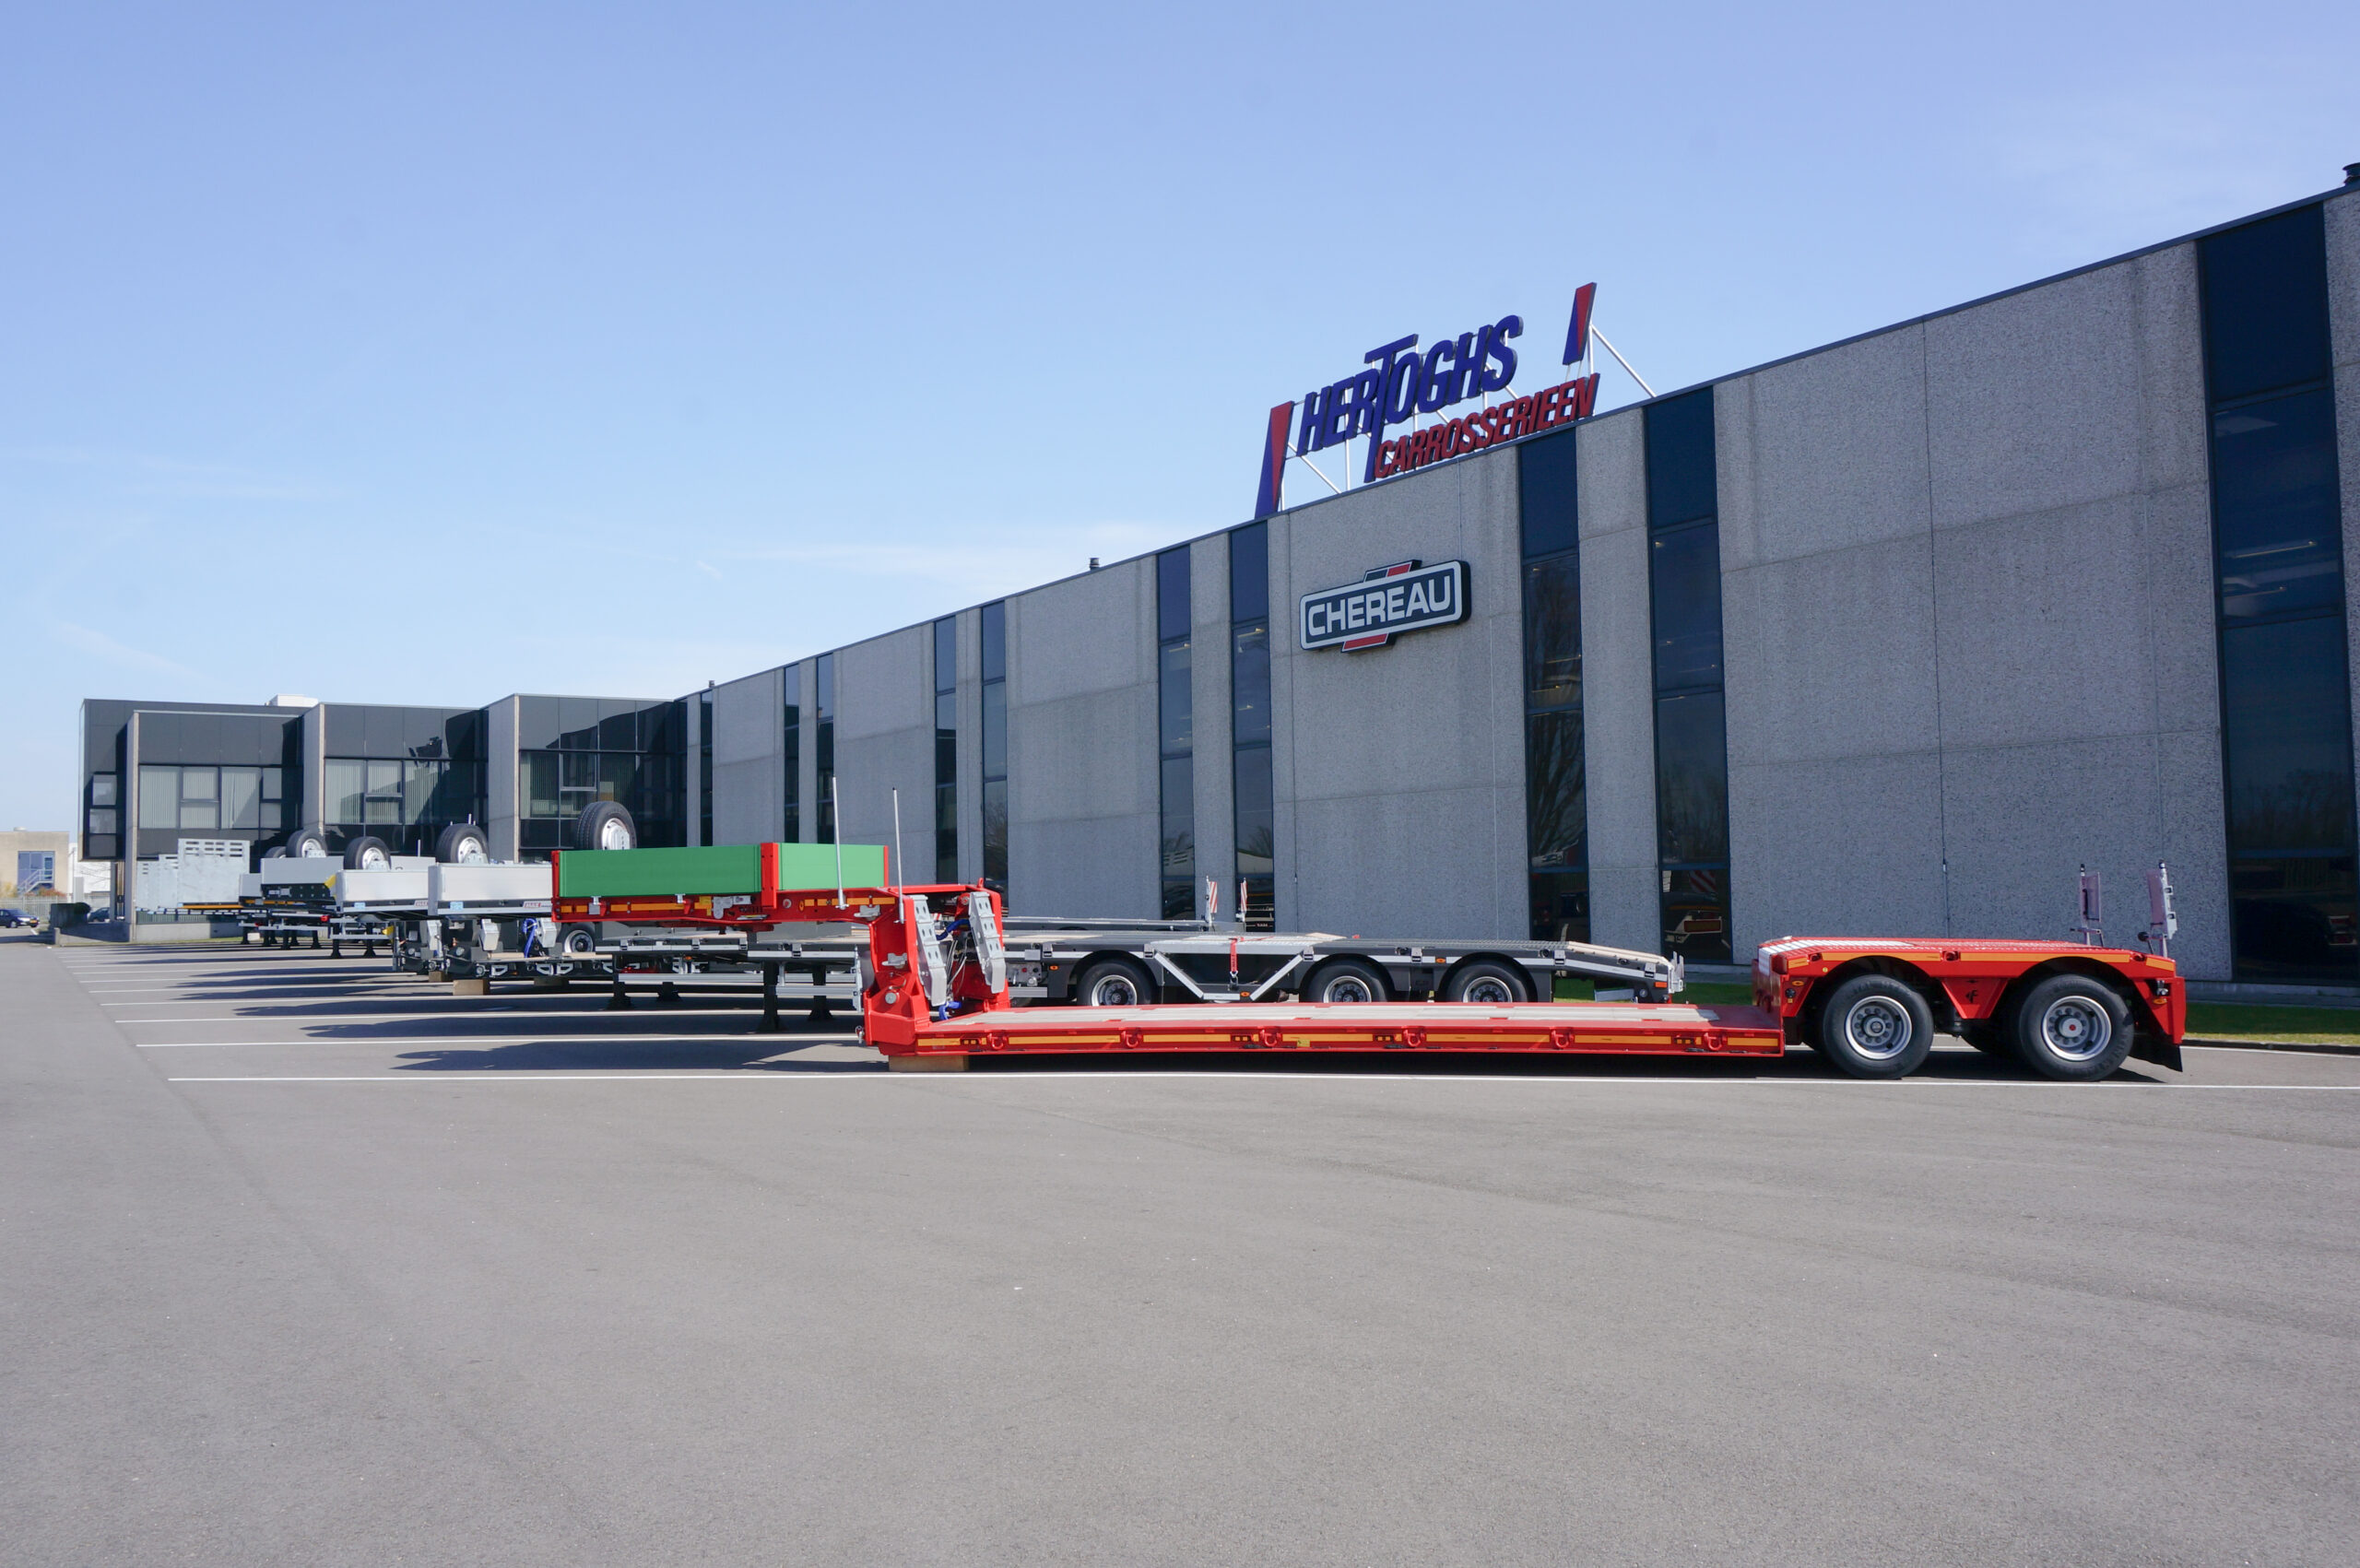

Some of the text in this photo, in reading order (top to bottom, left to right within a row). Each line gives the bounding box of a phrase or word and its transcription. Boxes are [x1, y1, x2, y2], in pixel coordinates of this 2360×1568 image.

[1296, 314, 1523, 483] HERTOGHS
[1374, 373, 1599, 478] CARROSSERIEEN
[1308, 575, 1451, 636] CHEREAU
